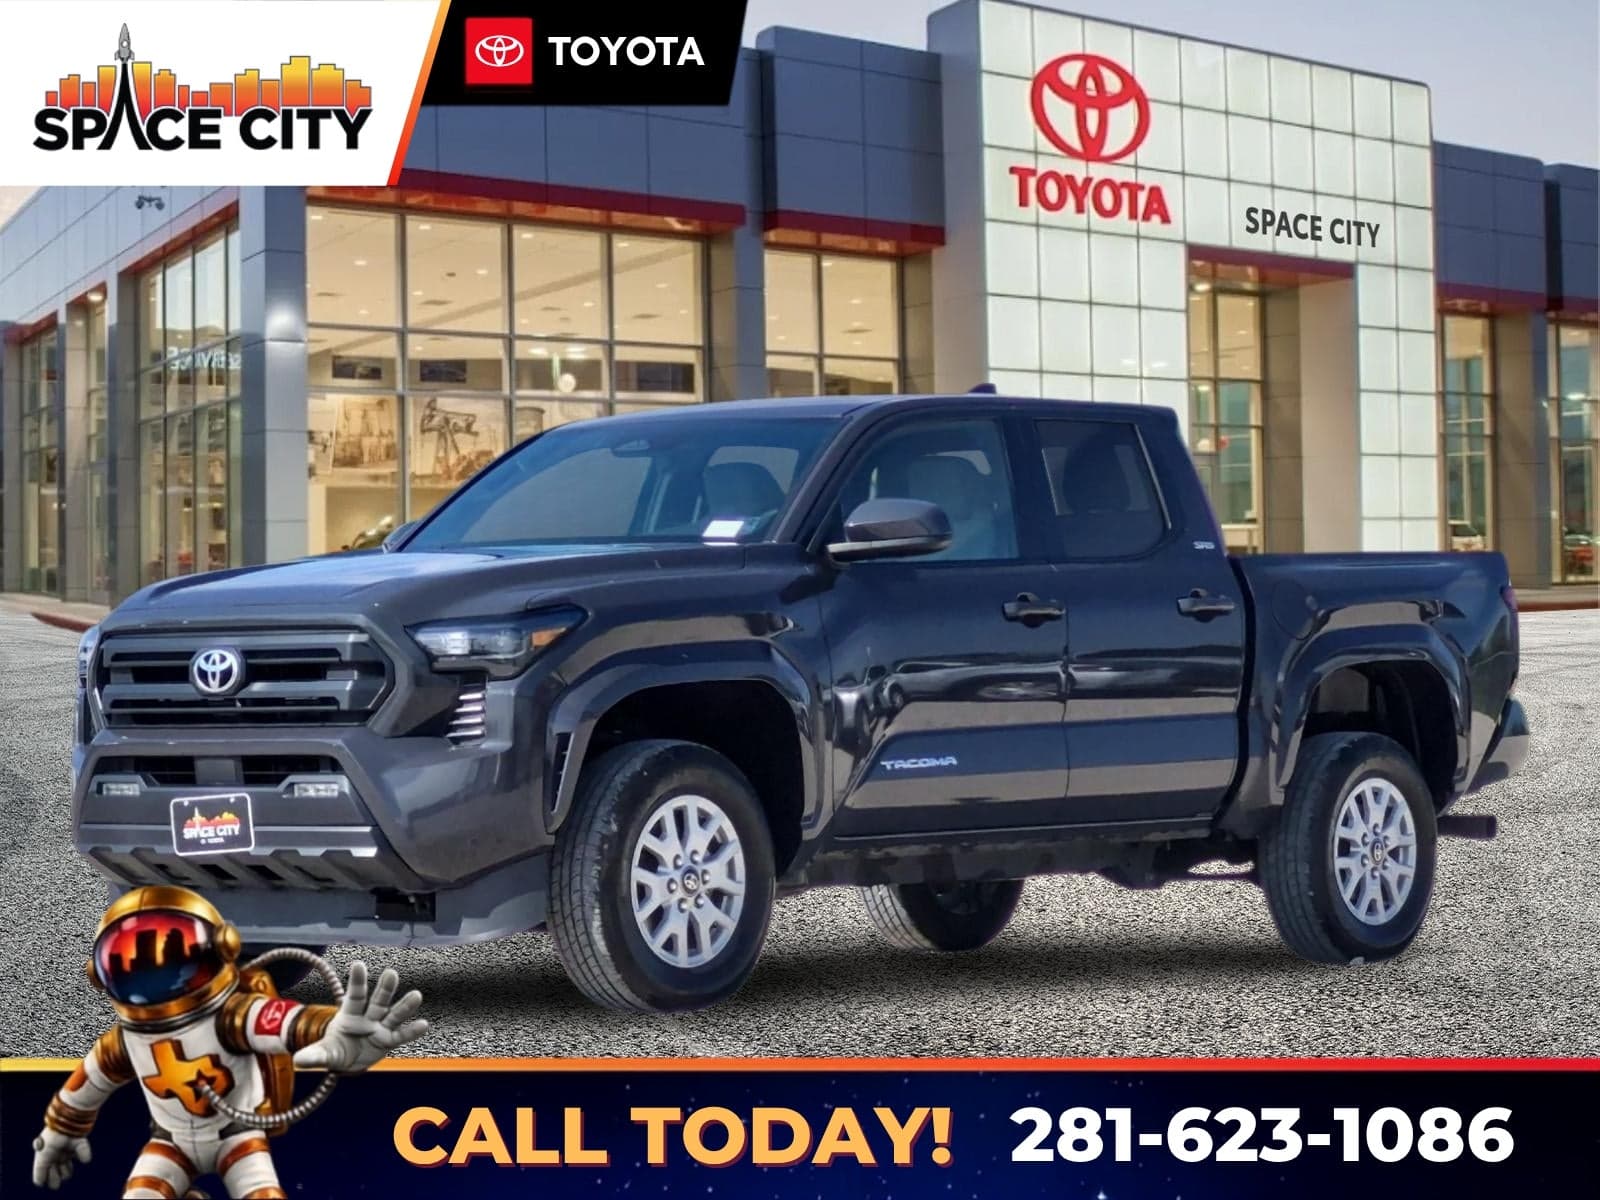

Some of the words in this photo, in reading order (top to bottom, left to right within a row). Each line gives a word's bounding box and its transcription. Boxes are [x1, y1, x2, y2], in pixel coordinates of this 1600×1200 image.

[1009, 166, 1171, 224] TOYOTA
[1246, 207, 1322, 242] SPACE
[1330, 218, 1381, 248] CITY
[880, 756, 958, 770] TACOMA
[216, 823, 240, 836] CITY
